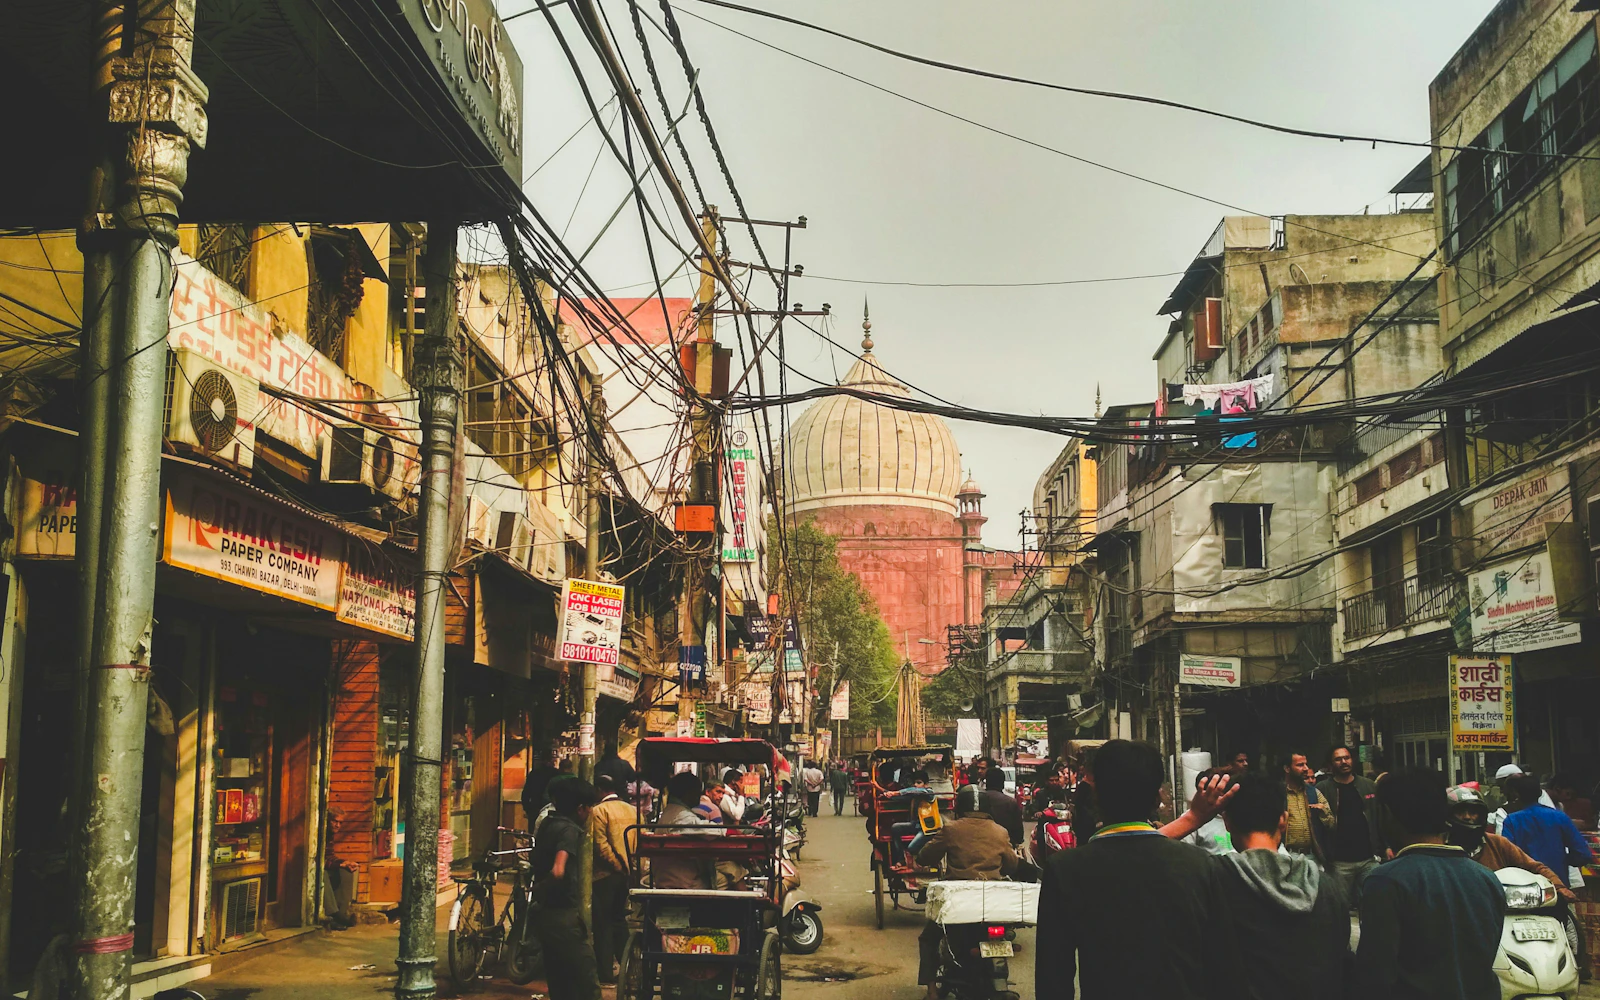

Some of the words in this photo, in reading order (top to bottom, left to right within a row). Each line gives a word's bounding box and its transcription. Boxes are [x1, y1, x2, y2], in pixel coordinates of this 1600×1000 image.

[438, 39, 456, 81] THE
[459, 76, 480, 121] CARD
[1493, 485, 1526, 510] DEEPAK
[1528, 476, 1548, 497] JAIN
[222, 497, 324, 566] RAKESH
[221, 537, 263, 565] PAPER
[268, 553, 319, 582] COMPANY
[234, 564, 258, 579] CHAWRI
[572, 580, 596, 591] SHEET
[597, 585, 620, 595] METAL
[342, 588, 386, 613] NATIONAL
[568, 602, 589, 612] JOB
[590, 605, 620, 617] WORK
[570, 592, 591, 603] CNC
[592, 596, 621, 608] LASER
[1487, 605, 1505, 619] Sindhu
[1505, 598, 1535, 615] Machinery
[1535, 595, 1554, 608] House
[361, 615, 386, 627] CHAWRI
[563, 643, 616, 664] 9810110476
[1459, 662, 1502, 683] शादी
[1456, 734, 1478, 743] अजय
[691, 945, 711, 954] JR
